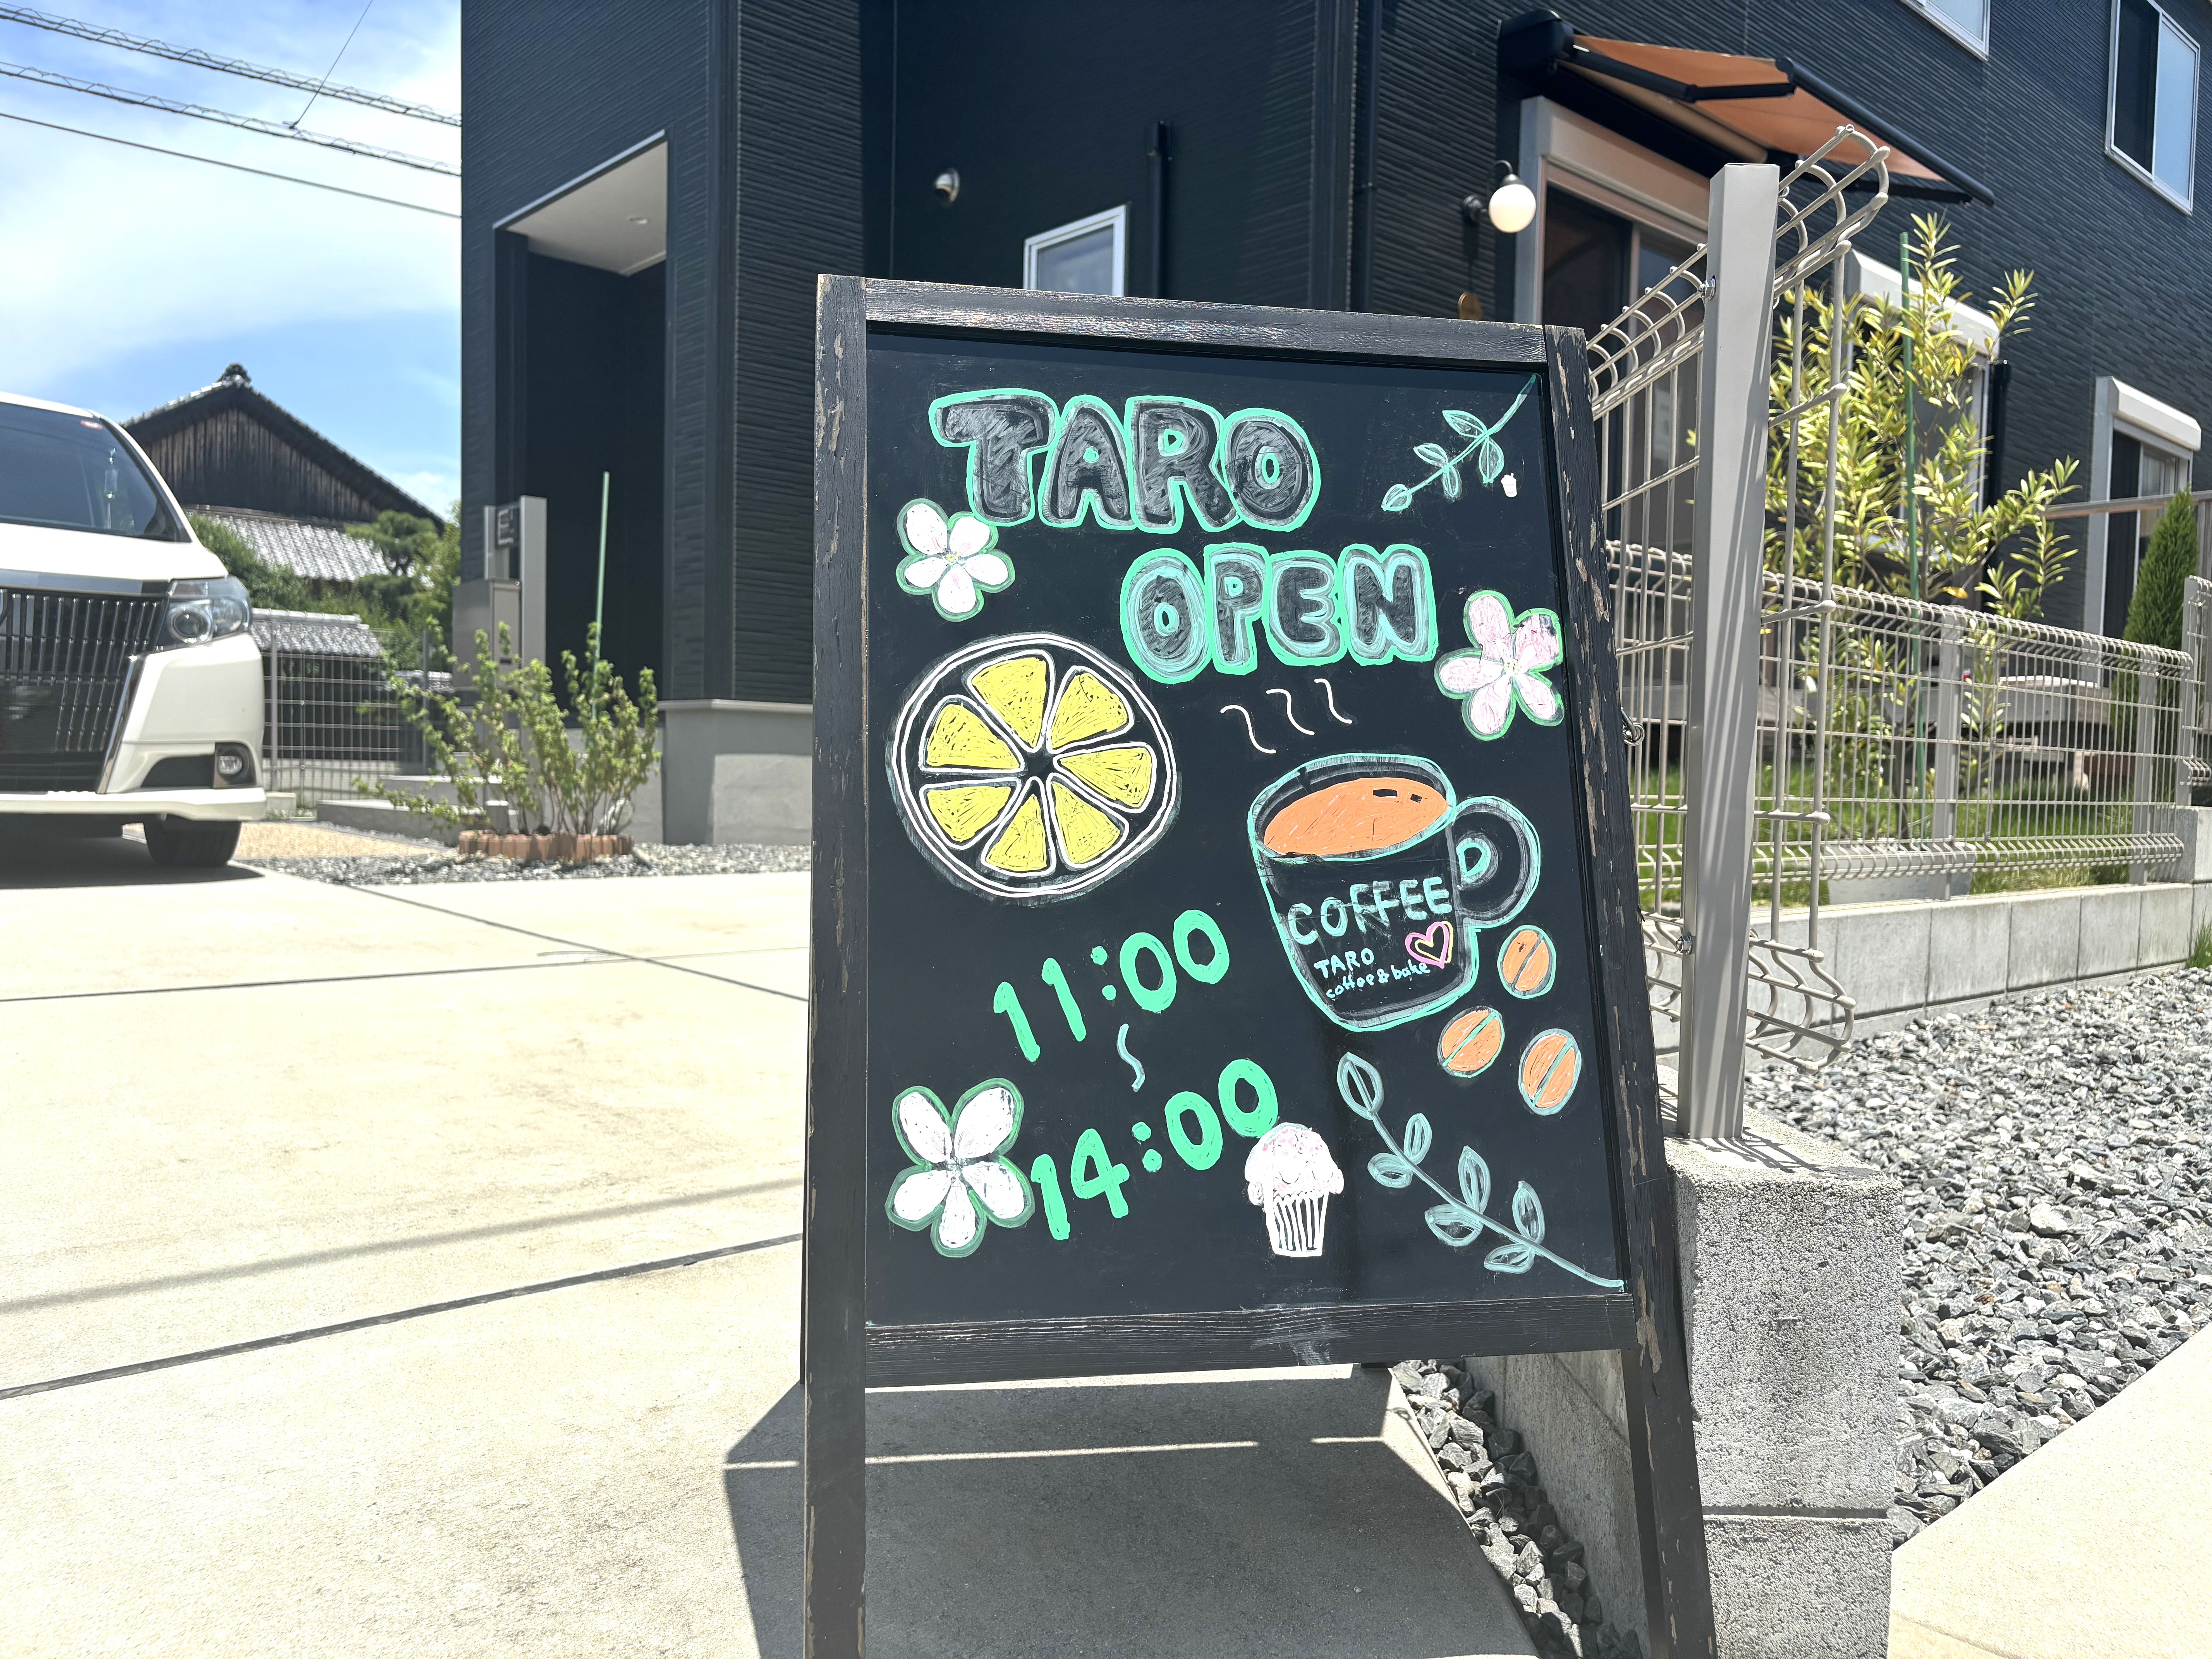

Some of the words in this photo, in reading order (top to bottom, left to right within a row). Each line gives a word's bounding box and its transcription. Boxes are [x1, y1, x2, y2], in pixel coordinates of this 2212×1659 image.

[929, 389, 1321, 533] TARO
[1120, 543, 1436, 683] OPEN
[1287, 876, 1453, 945] COFFEE
[1313, 948, 1374, 978] TARO
[993, 910, 1230, 1062] 11:00
[1030, 1059, 1278, 1240] 14:00
